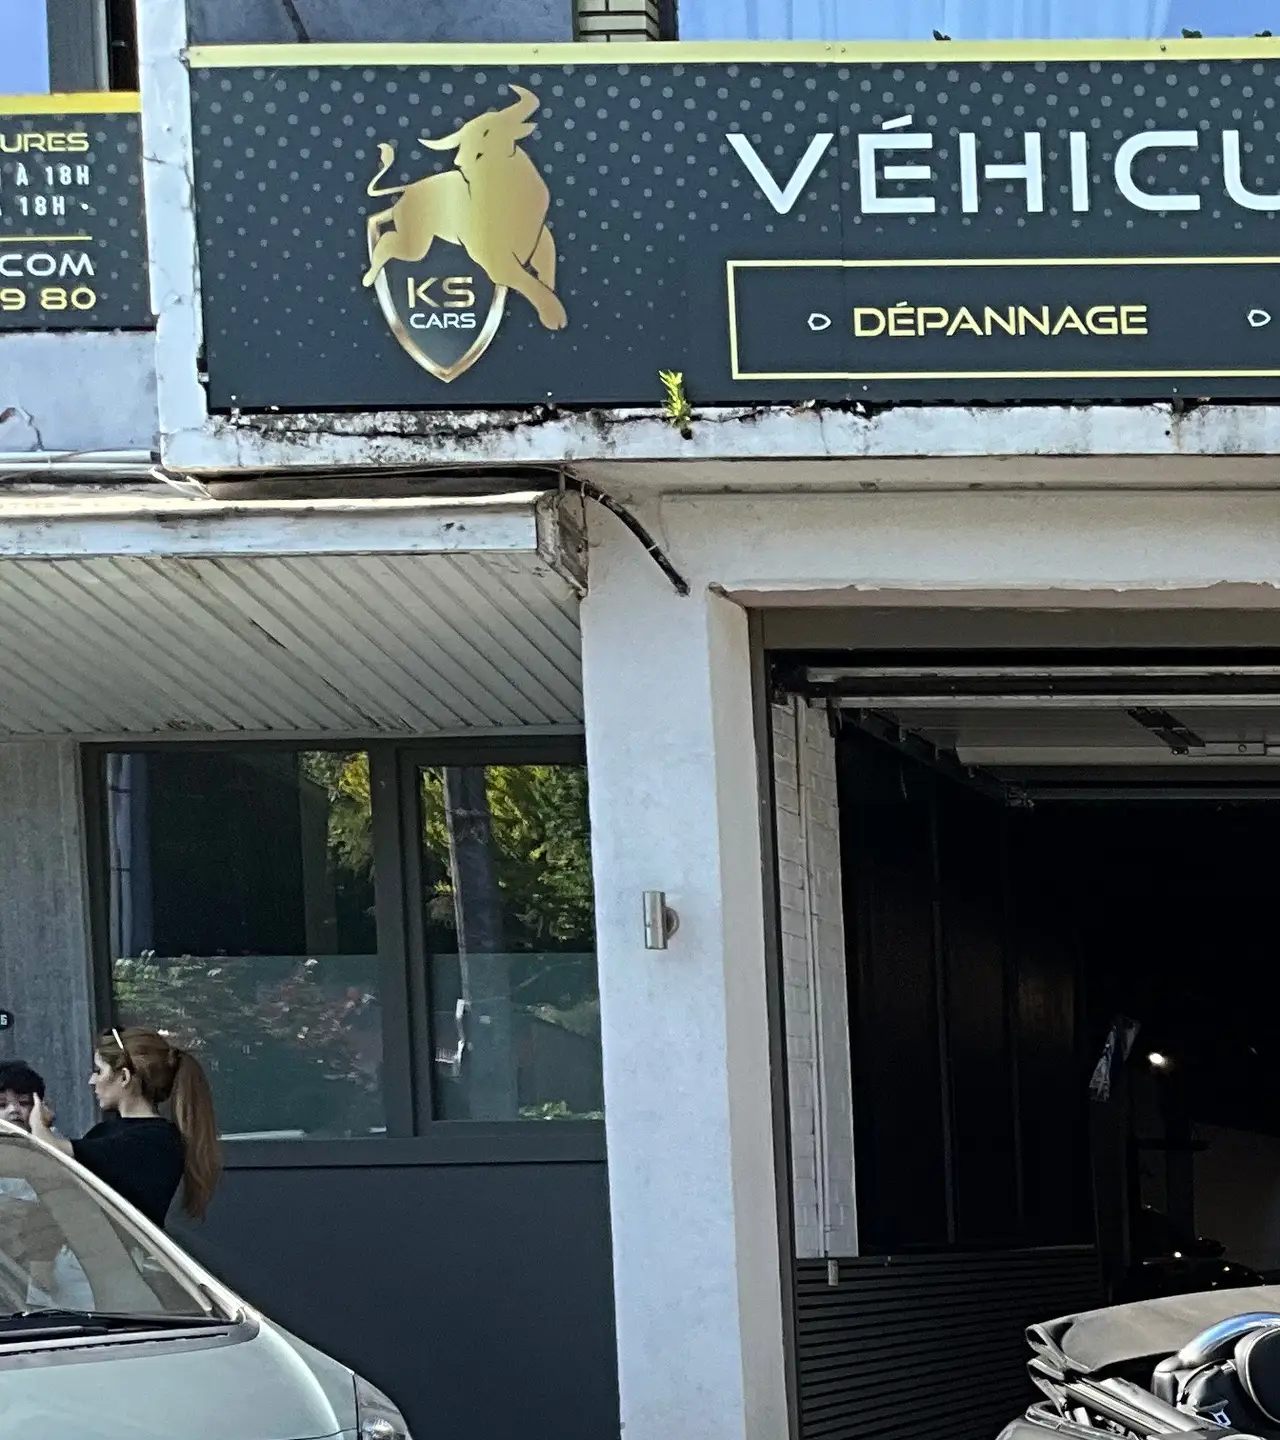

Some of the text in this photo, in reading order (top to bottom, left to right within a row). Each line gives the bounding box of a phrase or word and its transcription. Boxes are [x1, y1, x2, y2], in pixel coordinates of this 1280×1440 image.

[45, 165, 90, 186] 18H
[20, 195, 65, 216] 18H
[40, 287, 97, 310] 80
[407, 276, 475, 309] KS
[409, 312, 477, 330] CARS
[853, 301, 1148, 337] DÉPANNAGE
